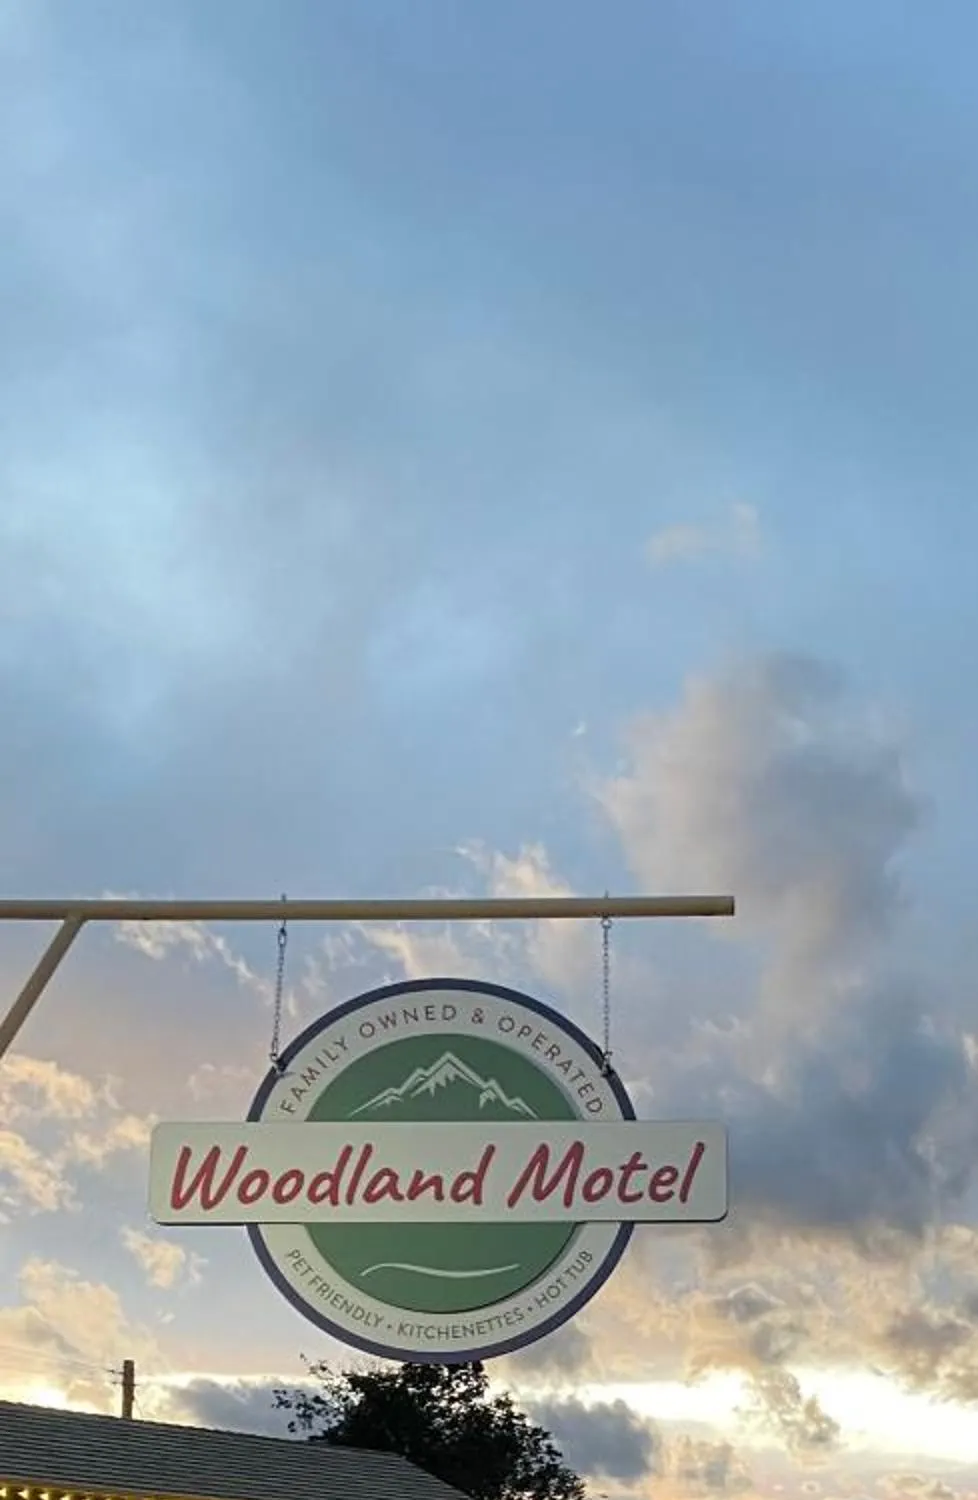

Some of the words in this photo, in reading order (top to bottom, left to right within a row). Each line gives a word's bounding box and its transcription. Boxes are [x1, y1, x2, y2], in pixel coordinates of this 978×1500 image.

[280, 1036, 348, 1114] FAMILY
[359, 1005, 457, 1038] OWNED
[471, 1007, 484, 1024] &
[498, 1015, 603, 1113] OPERATED
[170, 1143, 495, 1210] Woodland
[507, 1140, 705, 1209] Motel
[287, 1249, 315, 1277] PET
[308, 1273, 384, 1328] FRIENDLY
[397, 1307, 524, 1340] KITCHENETTES
[535, 1278, 568, 1308] HOT
[565, 1250, 593, 1280] TUB
